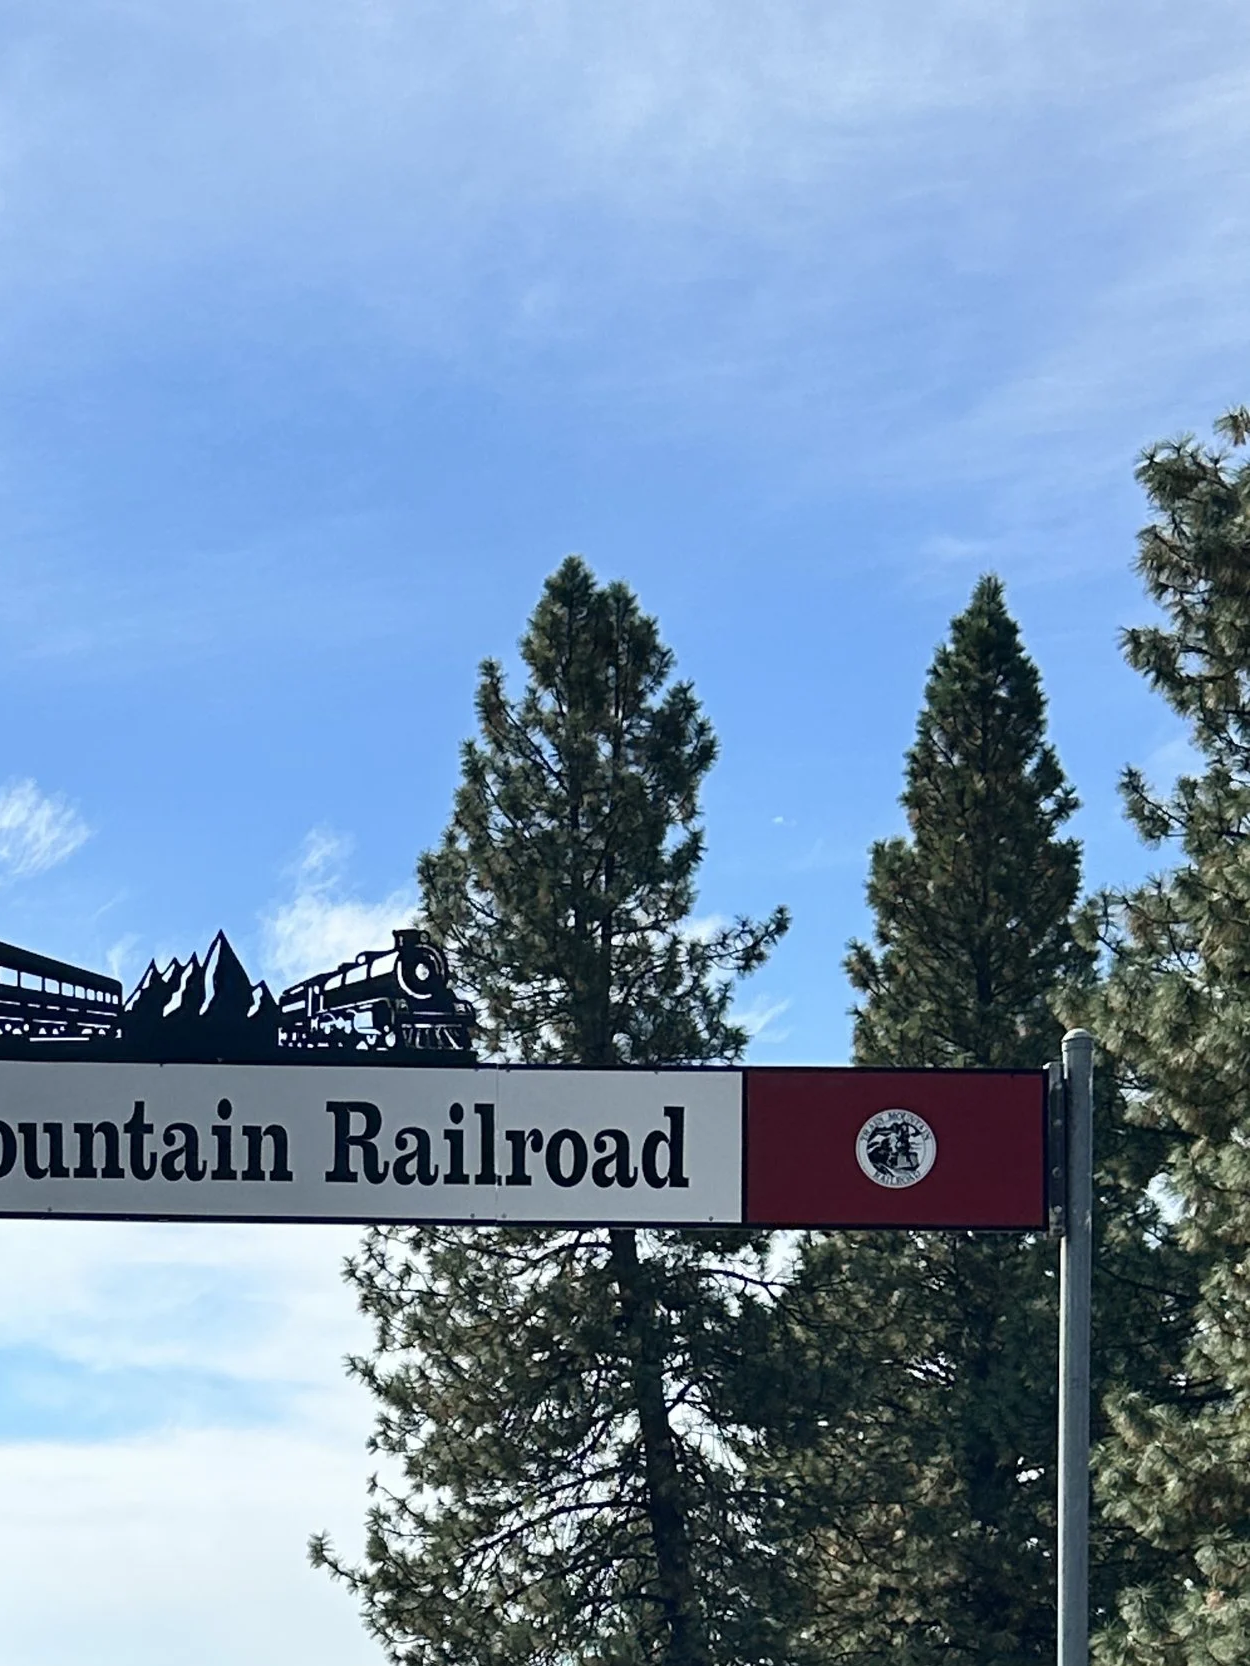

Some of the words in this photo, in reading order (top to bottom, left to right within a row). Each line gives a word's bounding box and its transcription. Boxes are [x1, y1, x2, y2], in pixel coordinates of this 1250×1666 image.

[888, 1111, 931, 1141] MOUNTAIN
[324, 1100, 689, 1189] Railroad
[873, 1170, 921, 1186] RAILROAD
